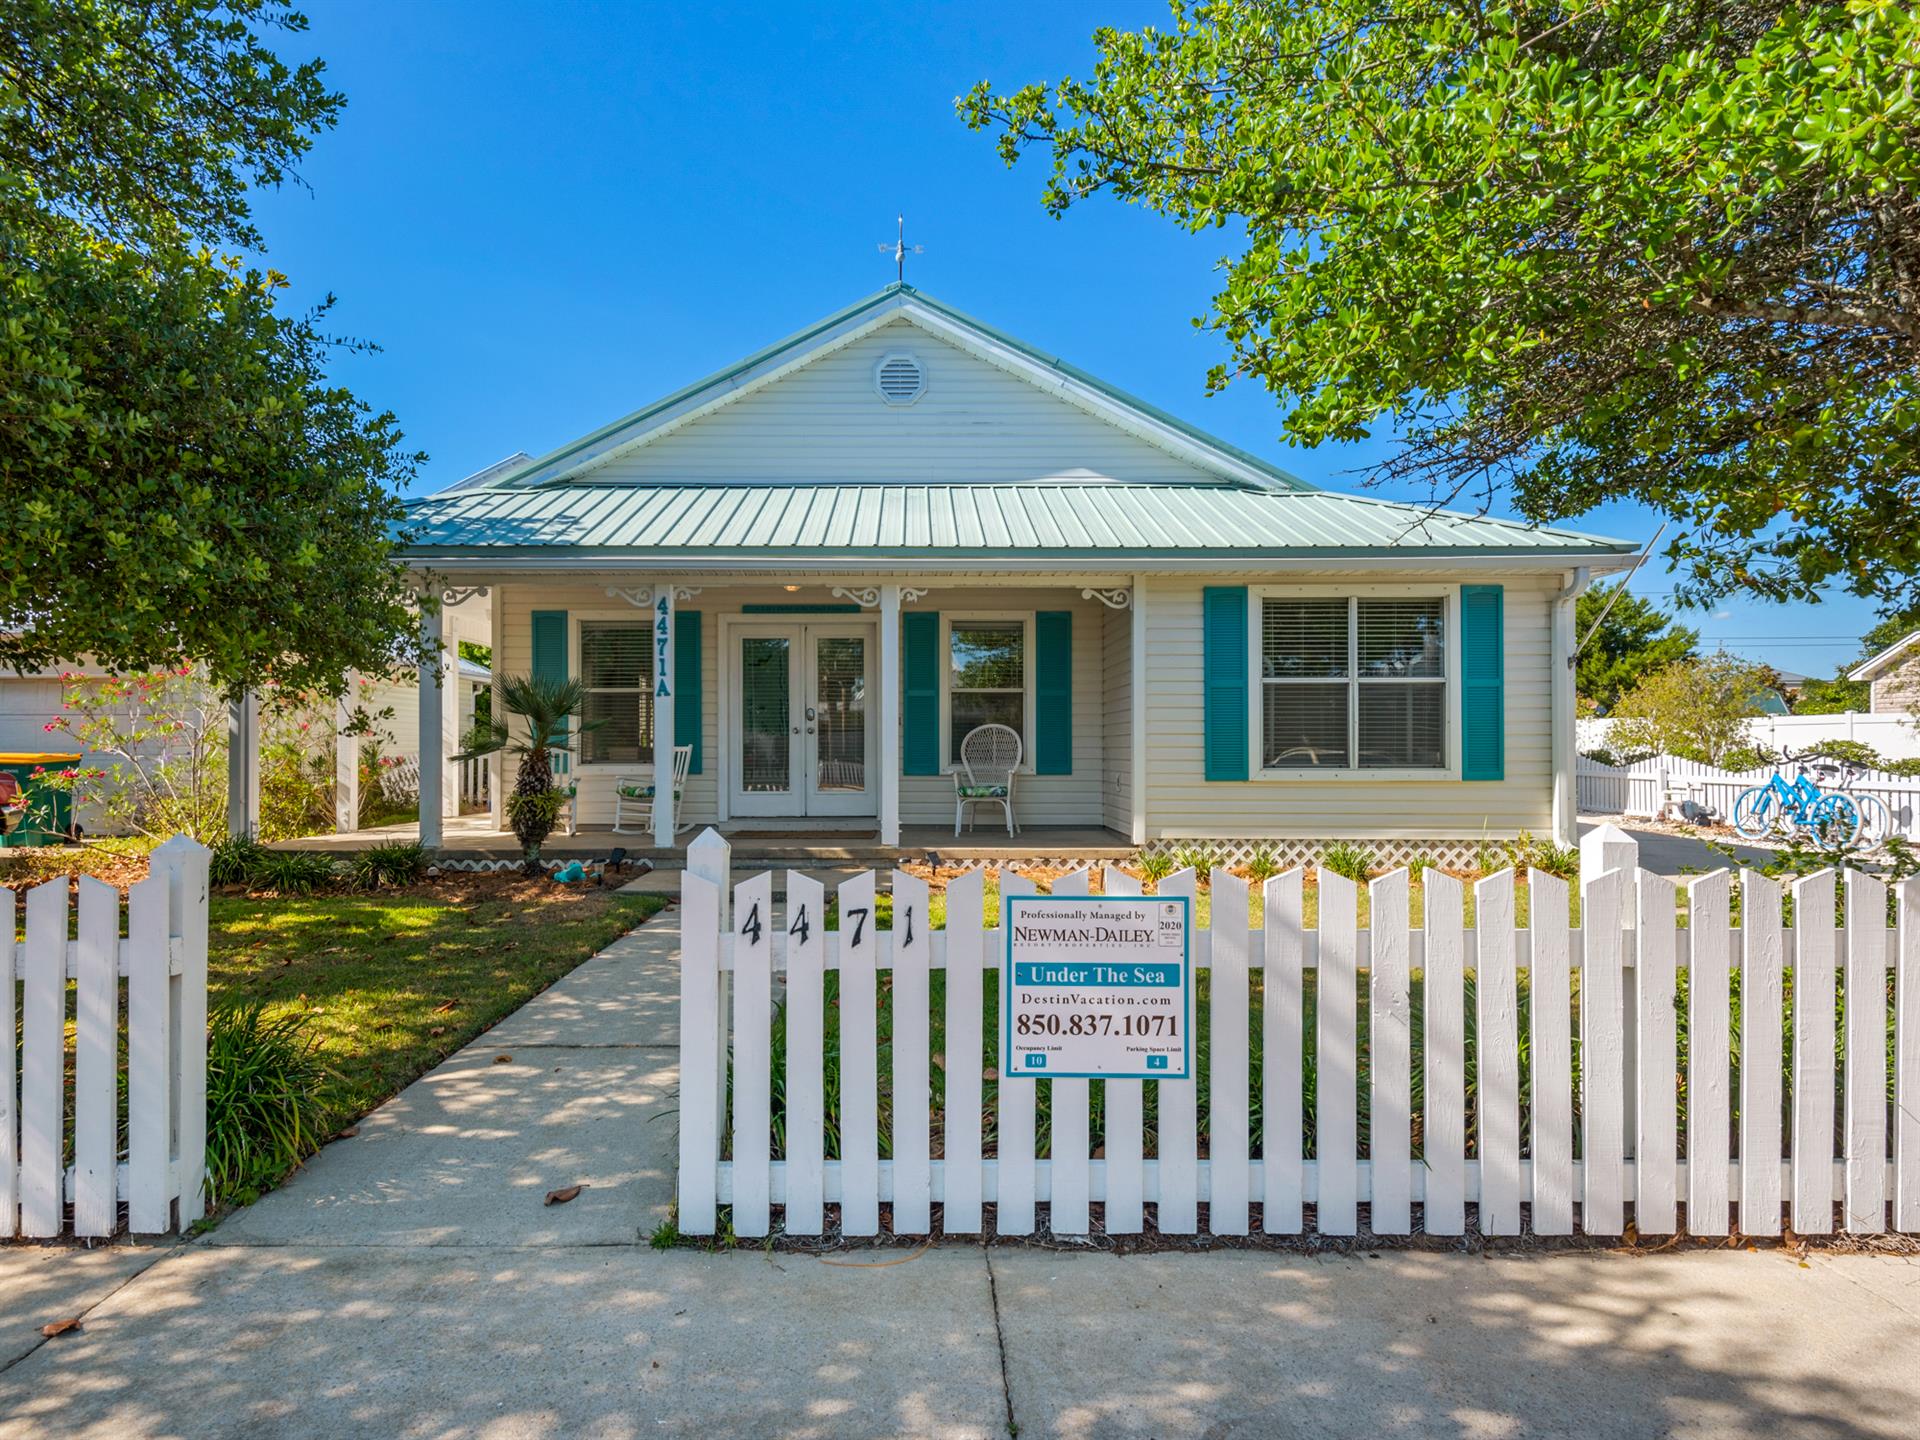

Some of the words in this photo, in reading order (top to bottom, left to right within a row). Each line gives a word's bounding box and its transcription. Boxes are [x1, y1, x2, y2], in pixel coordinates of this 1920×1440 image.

[656, 596, 671, 697] 4471A
[1020, 910, 1087, 921] Professionally
[1090, 911, 1132, 921] Managed
[1134, 911, 1146, 921] by
[1159, 921, 1182, 930] 2020
[1031, 966, 1088, 983] Under
[1093, 967, 1128, 983] The
[1134, 967, 1165, 983] Sea
[1022, 993, 1171, 1006] DestinVacation.com
[1017, 1014, 1179, 1037] 850.837.1071
[1031, 1056, 1043, 1065] 10
[1153, 1057, 1160, 1066] 4
